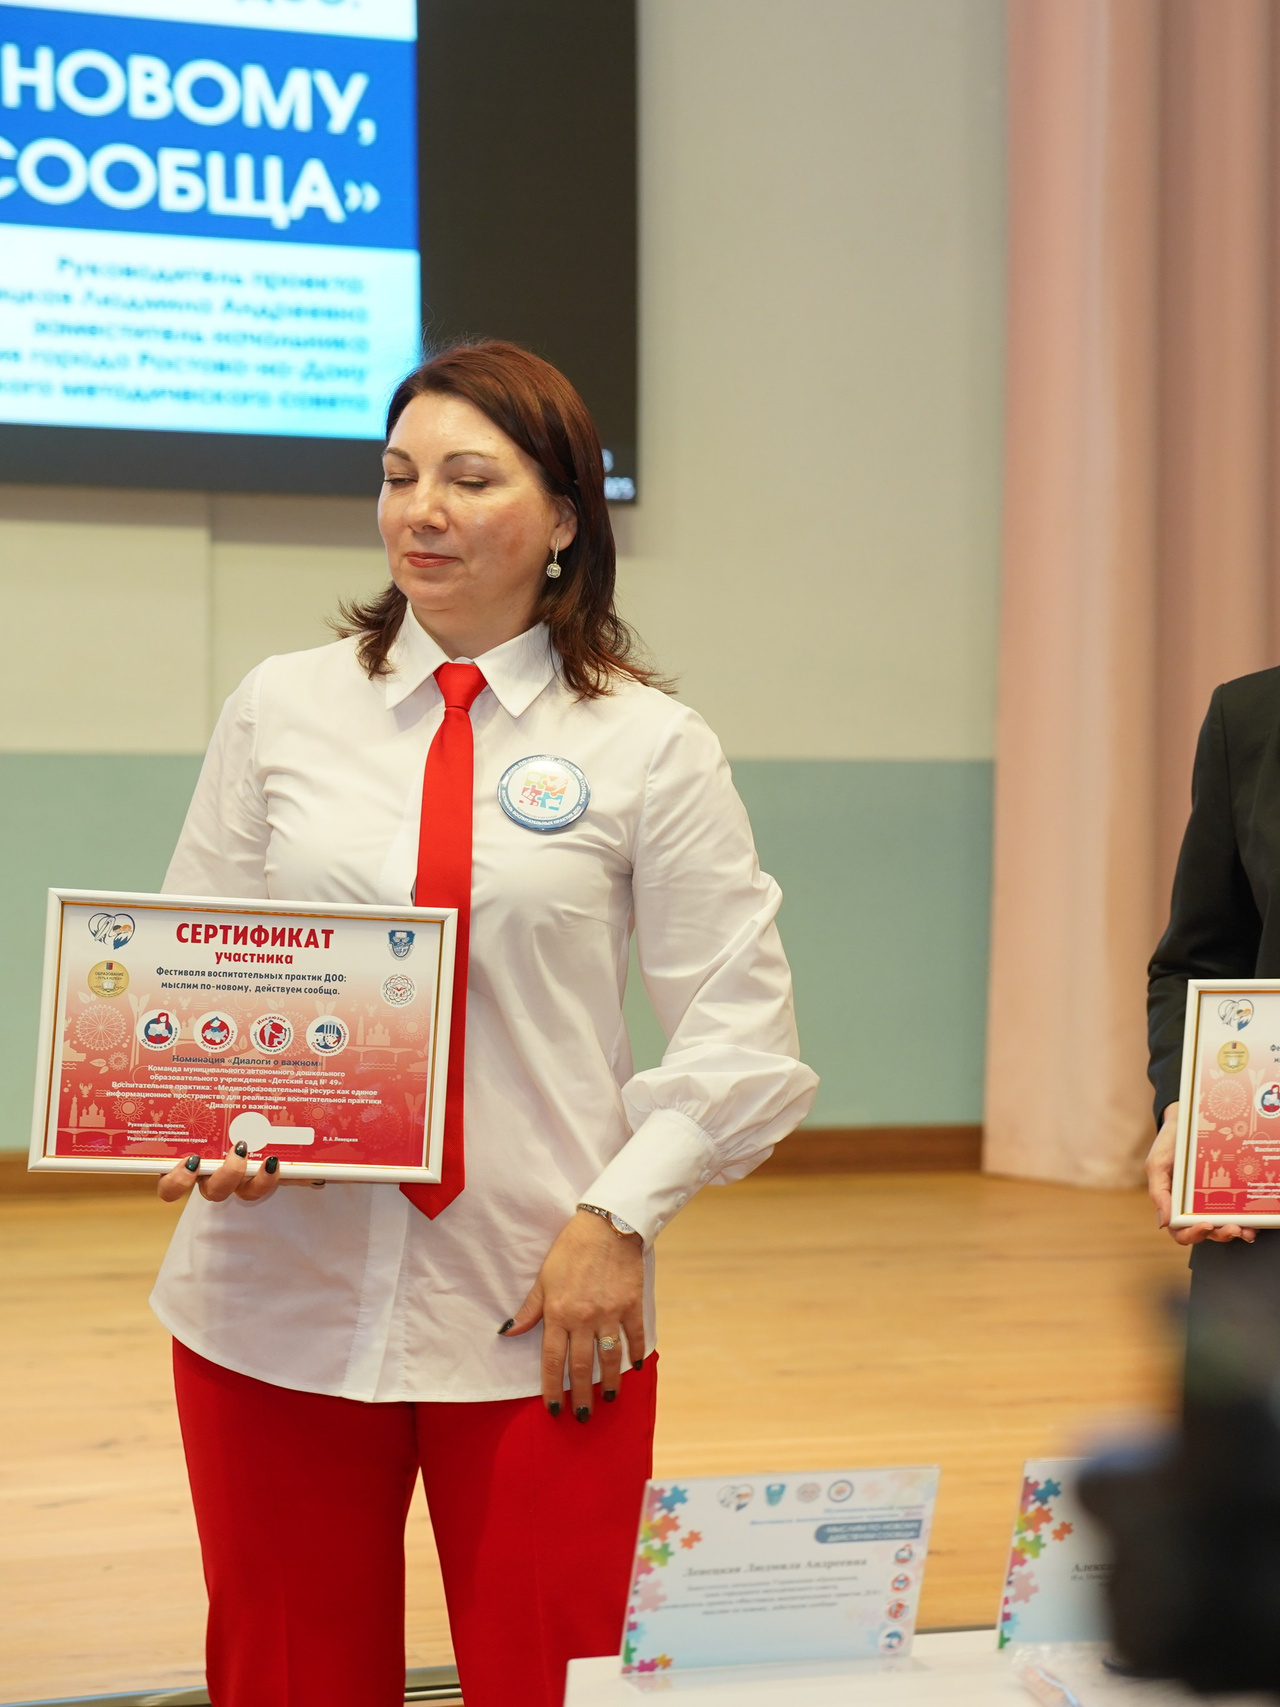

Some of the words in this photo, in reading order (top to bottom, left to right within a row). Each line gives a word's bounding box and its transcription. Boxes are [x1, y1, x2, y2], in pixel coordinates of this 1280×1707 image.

[1, 40, 377, 146] НОВОМУ,
[176, 922, 335, 949] СЕРТИФИКАТ
[215, 951, 294, 965] участника
[156, 967, 206, 977] Фестиваля
[207, 970, 283, 981] воспитательных
[285, 973, 322, 982] практик
[324, 973, 347, 983] ДОО:
[161, 981, 199, 990] мыслим
[200, 983, 252, 993] по-новому,
[254, 984, 302, 994] действуем
[303, 986, 341, 996] сообща.
[172, 1054, 225, 1065] Номинация
[228, 1056, 271, 1066] «Диалоги
[148, 1064, 182, 1073] Команда
[183, 1066, 245, 1075] муниципального
[246, 1068, 295, 1076] автономного
[296, 1069, 345, 1078] дошкольного
[150, 1073, 218, 1082] образовательного
[220, 1076, 266, 1084] учреждения
[268, 1078, 304, 1086] «Детский
[112, 1081, 173, 1090] Воспитательная
[174, 1083, 212, 1091] практика:
[310, 1086, 335, 1095] ресурс
[351, 1089, 378, 1097] единое
[106, 1091, 172, 1099] информационное
[173, 1093, 226, 1101] пространство
[242, 1095, 286, 1103] реализации
[287, 1096, 346, 1104] воспитательной
